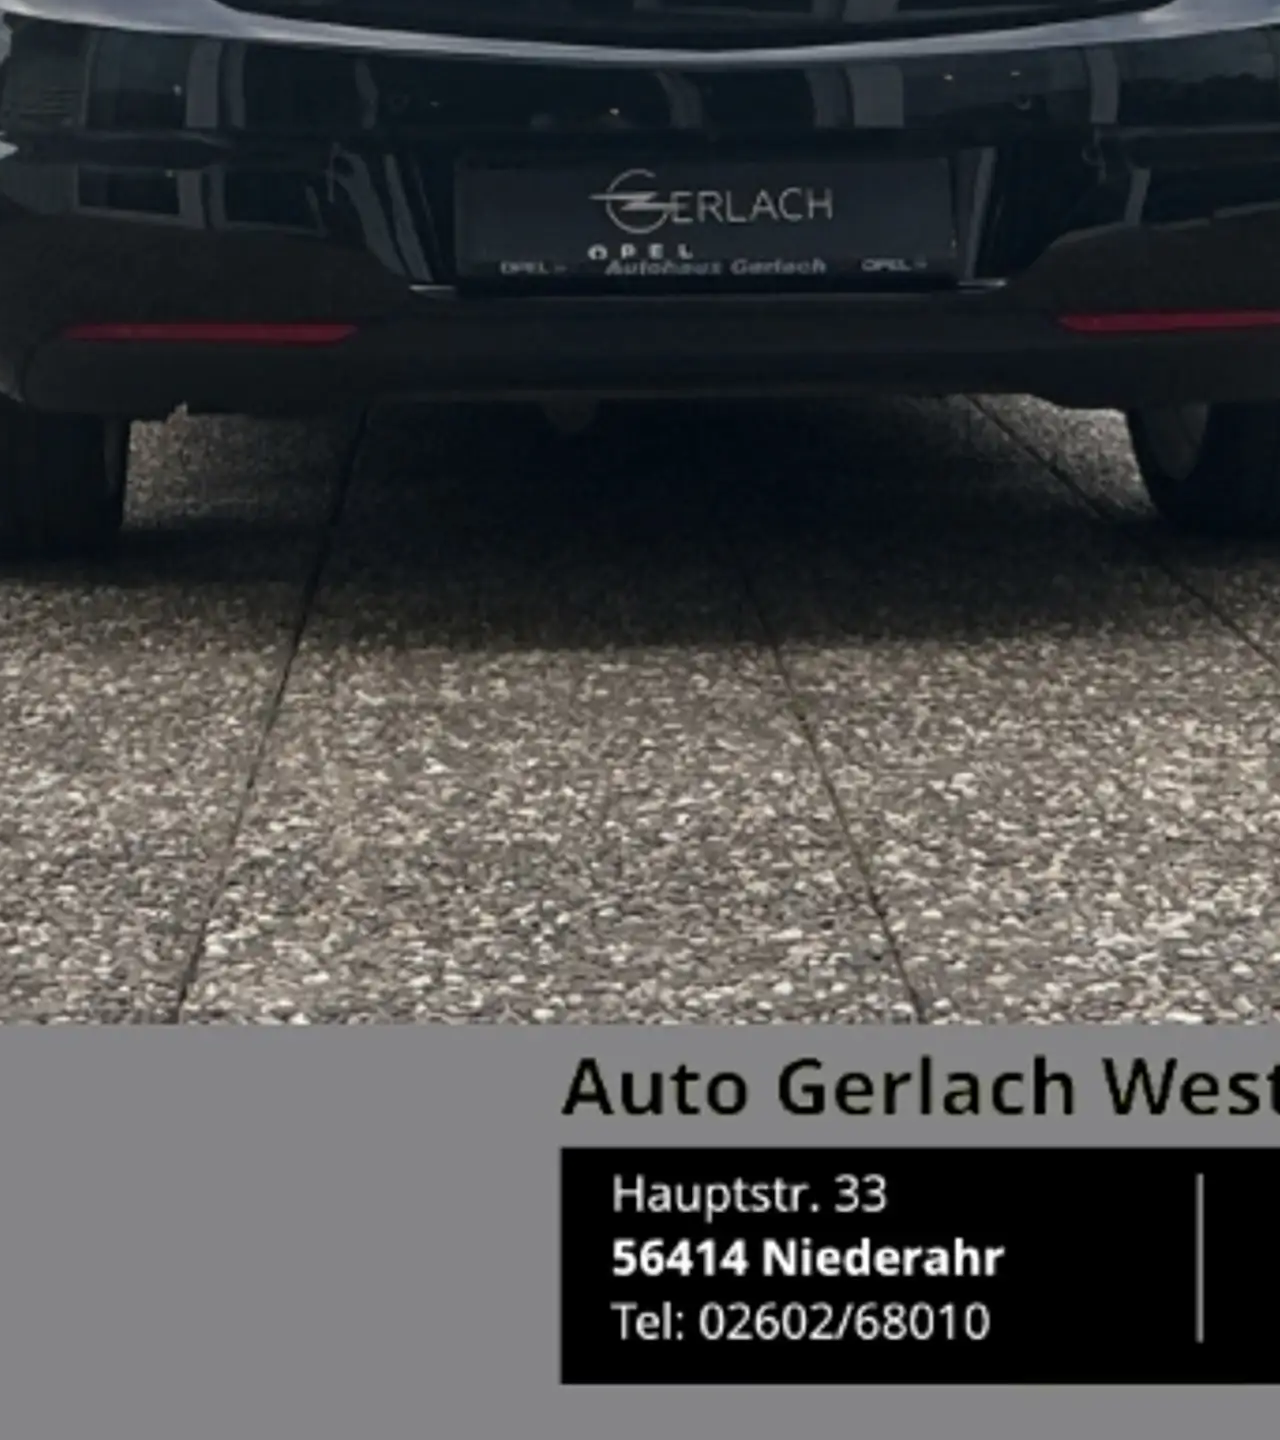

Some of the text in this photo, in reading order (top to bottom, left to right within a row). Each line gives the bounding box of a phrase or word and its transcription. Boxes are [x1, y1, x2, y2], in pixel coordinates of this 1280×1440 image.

[587, 243, 694, 260] OPEL
[604, 258, 827, 276] Autohaus Gerlach
